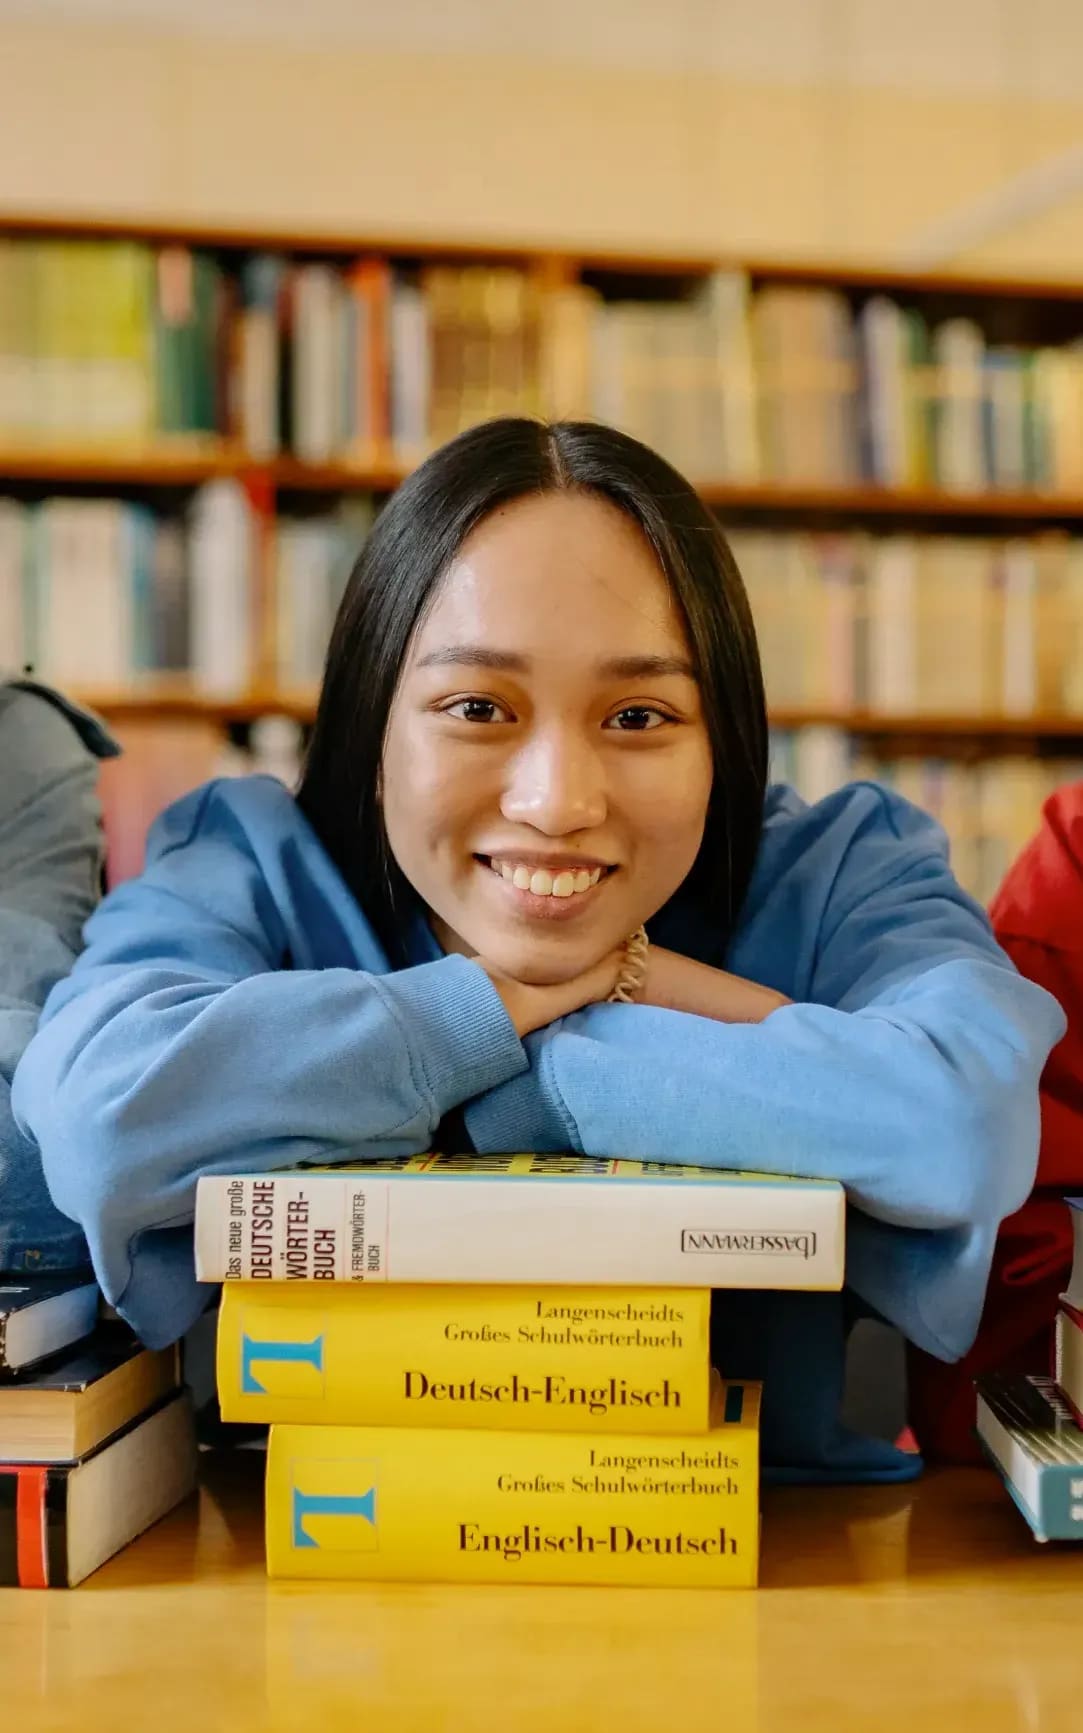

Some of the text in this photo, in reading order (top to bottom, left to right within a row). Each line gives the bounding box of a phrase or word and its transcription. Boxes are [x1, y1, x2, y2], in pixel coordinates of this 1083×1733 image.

[225, 1180, 246, 1280] Das neue große
[251, 1181, 275, 1280] DEUTSCHE
[280, 1191, 309, 1281] WÖRTER-
[313, 1229, 336, 1281] BUCH
[368, 1245, 381, 1272] BUCH
[535, 1301, 684, 1325] Langenscheidts
[444, 1323, 684, 1348] Großes Schulwörterbuch
[403, 1371, 682, 1416] Deutsch-Englisch
[589, 1450, 739, 1472] Langenscheidts
[497, 1474, 739, 1495] Großes Schulwörterbuch
[457, 1523, 738, 1561] Englisch-Deutsch
